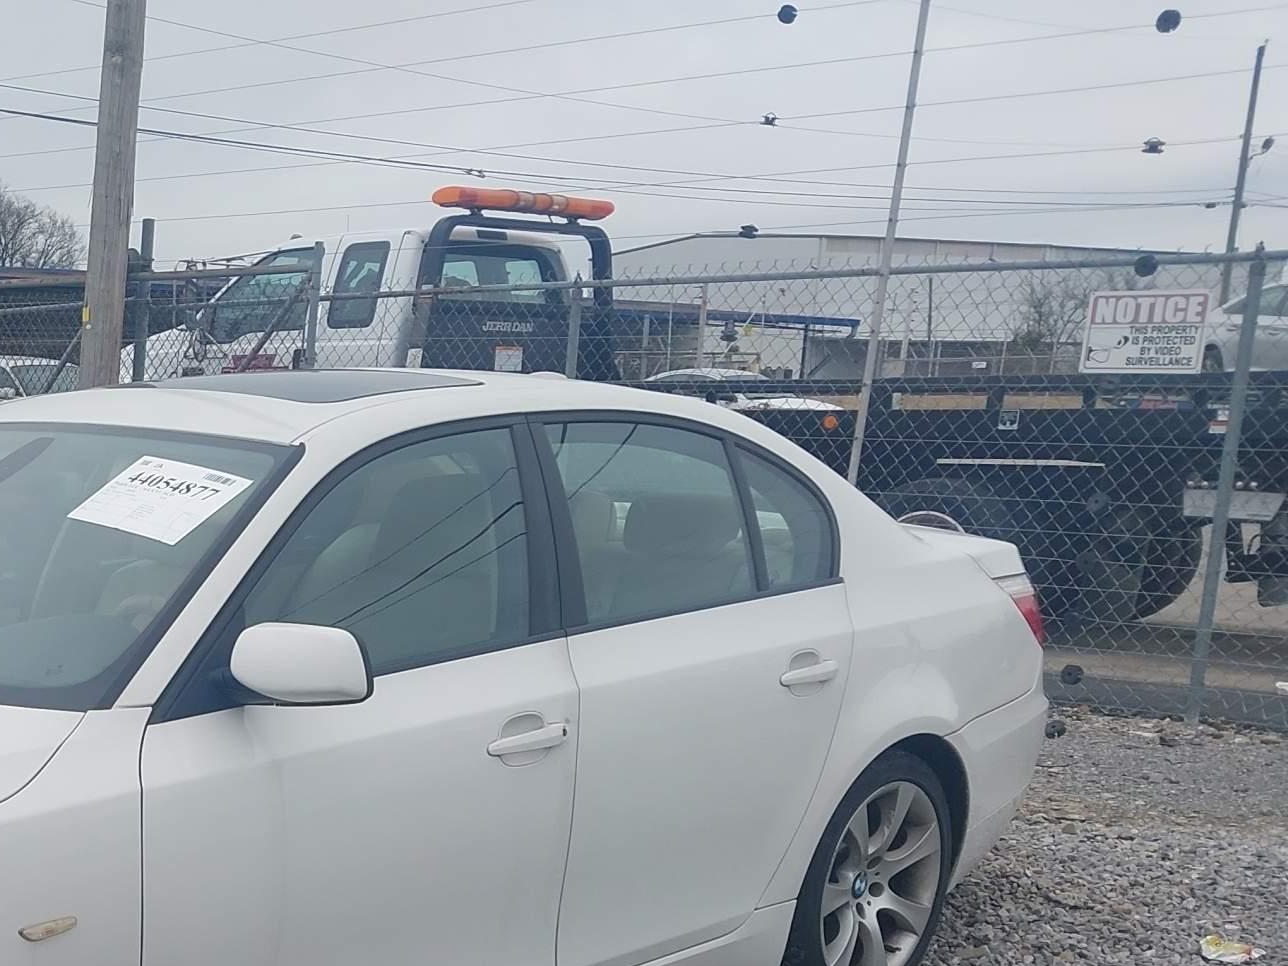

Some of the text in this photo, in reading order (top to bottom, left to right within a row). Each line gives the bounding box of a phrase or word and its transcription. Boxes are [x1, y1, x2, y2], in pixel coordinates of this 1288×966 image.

[1095, 295, 1205, 323] NOTICE
[1130, 325, 1199, 335] THIS PROPERTY
[1132, 335, 1196, 346] IS PROTECTED
[1140, 346, 1182, 356] BY VIDEO
[1125, 356, 1193, 366] SURVEILLANCE
[127, 471, 221, 501] 44054877
